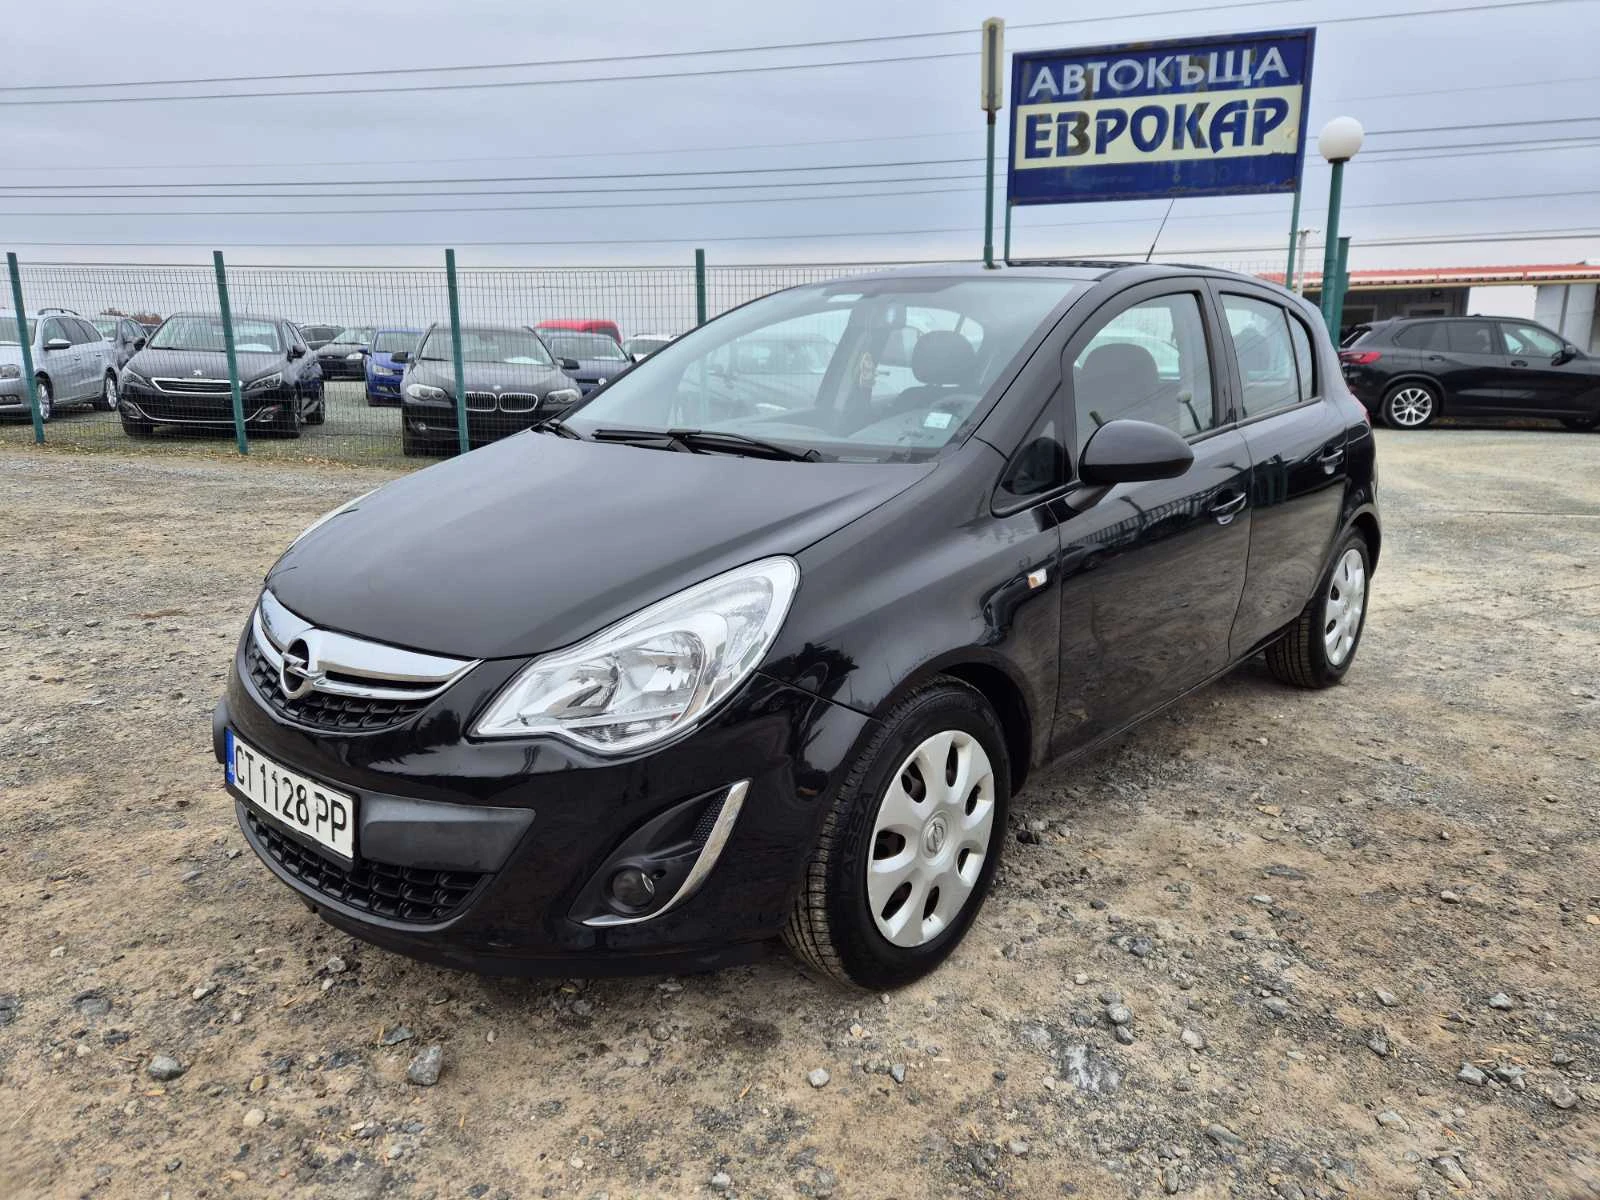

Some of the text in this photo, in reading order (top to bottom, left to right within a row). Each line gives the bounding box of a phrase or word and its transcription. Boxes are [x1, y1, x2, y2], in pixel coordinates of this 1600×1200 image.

[1027, 46, 1290, 99] АВТОКЪЩА
[1024, 97, 1290, 160] ЕВРОКАР
[260, 763, 310, 826] 1128
